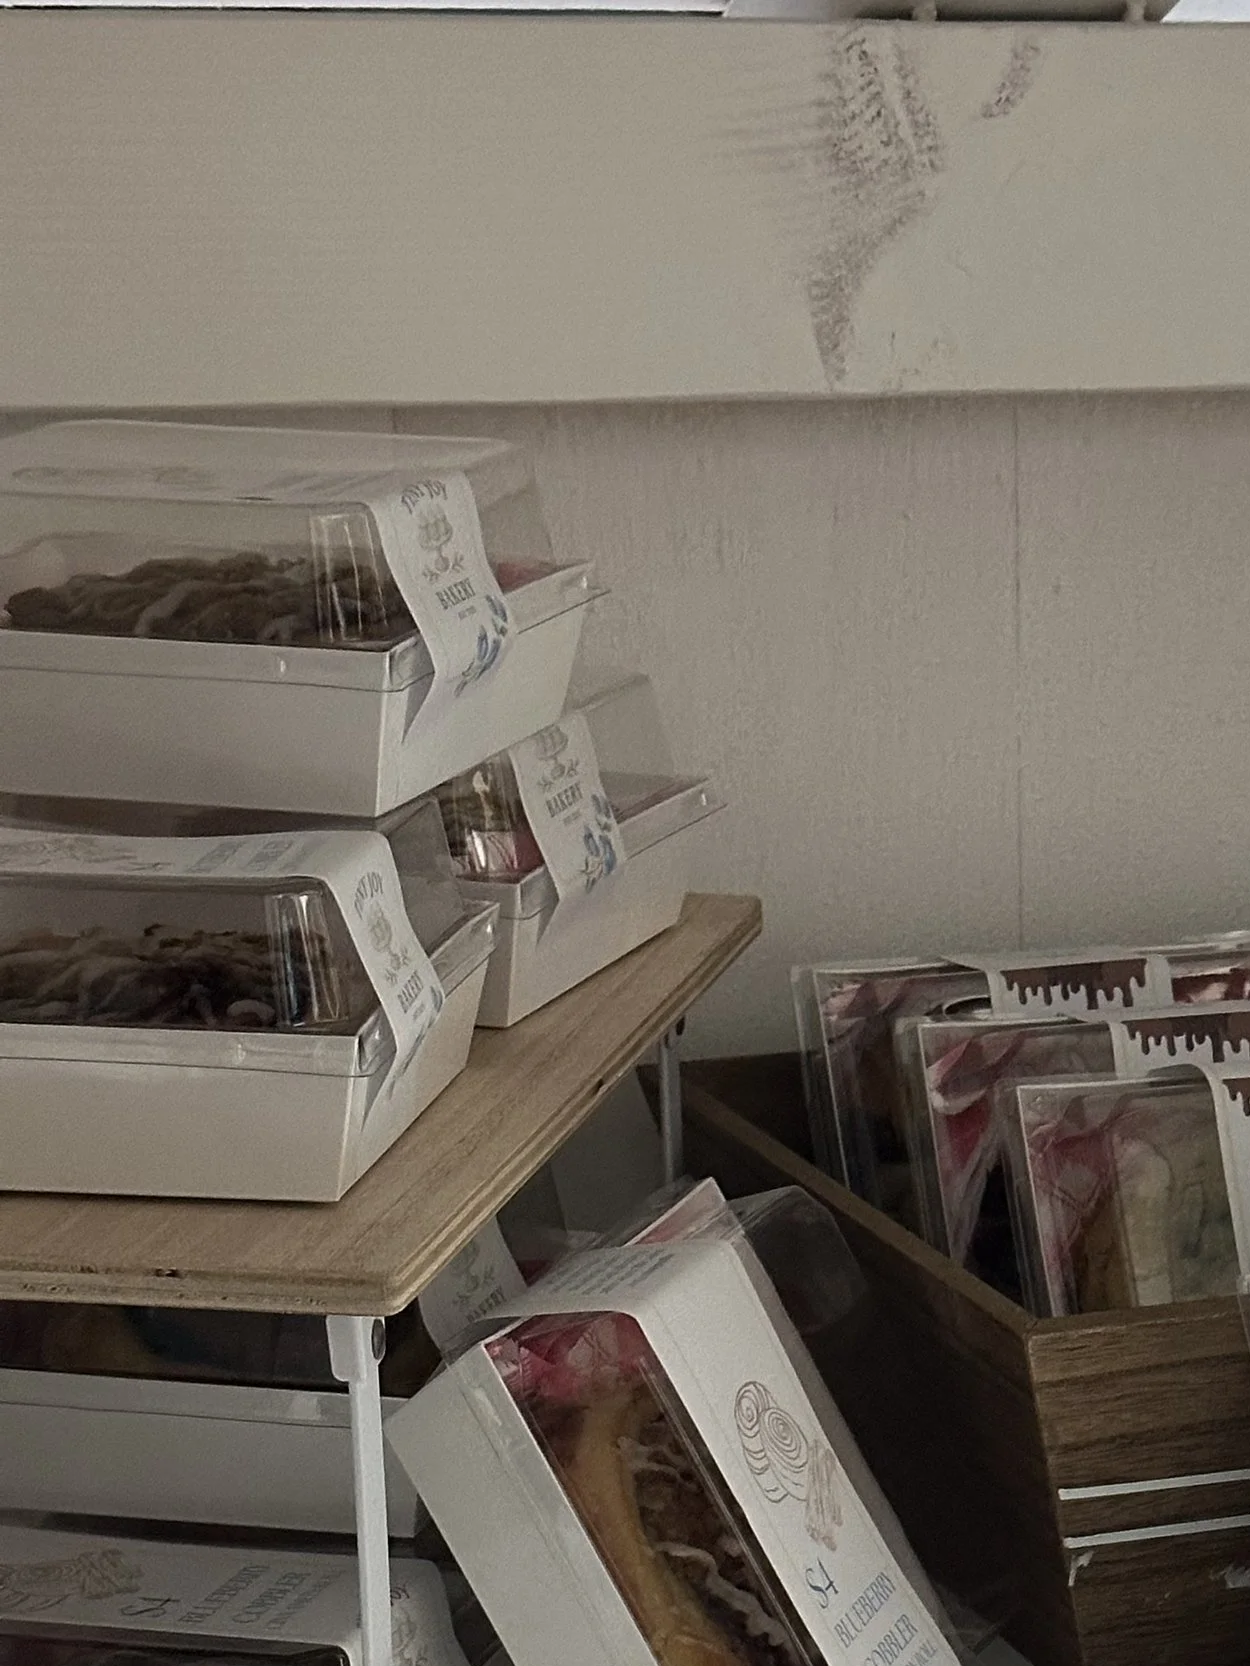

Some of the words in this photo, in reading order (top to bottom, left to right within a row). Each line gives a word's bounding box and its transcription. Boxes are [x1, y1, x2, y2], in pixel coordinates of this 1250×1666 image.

[436, 577, 477, 611] BAKERY
[545, 782, 584, 819] BAKERY
[397, 970, 425, 1015] BAKERY
[834, 1571, 898, 1649] BLUEBERRY
